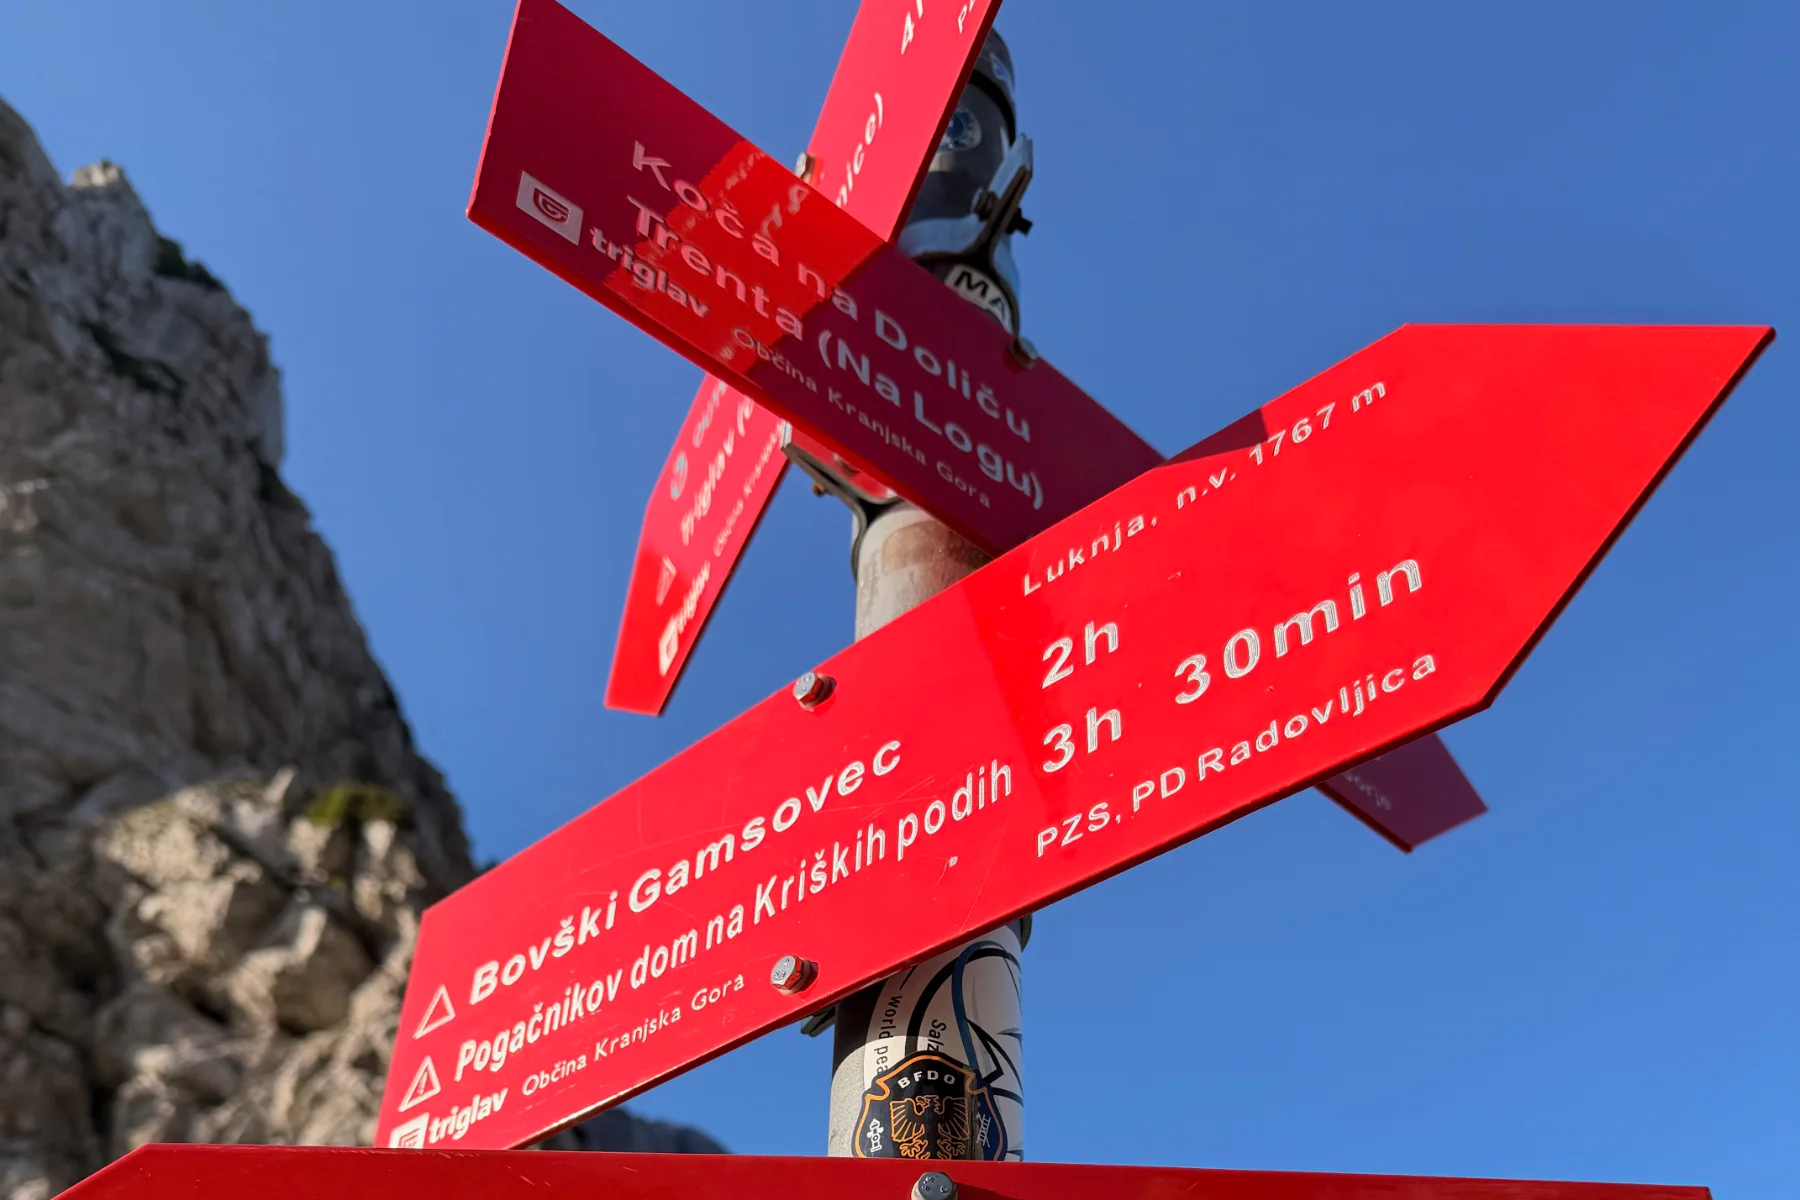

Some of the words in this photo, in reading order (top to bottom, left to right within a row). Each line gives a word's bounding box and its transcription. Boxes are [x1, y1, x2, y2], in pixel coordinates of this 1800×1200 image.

[590, 227, 710, 317] triglav
[733, 327, 818, 394] Občina
[828, 387, 926, 466] Kranjska
[936, 461, 990, 508] Gora
[627, 195, 803, 341] Trenta
[818, 330, 901, 407] (Na
[913, 391, 1043, 510] Logu)
[632, 140, 780, 266] Koča
[798, 263, 858, 321] na
[875, 309, 1030, 442] Doliču
[1024, 515, 1156, 596] Luknja,
[1177, 468, 1235, 509] n.v.
[1248, 403, 1335, 465] 1767
[1352, 382, 1385, 412] m
[455, 970, 622, 1082] Pogačnikov
[631, 929, 697, 989] dom
[706, 905, 744, 941] na
[753, 830, 886, 925] Kriških
[896, 761, 1011, 862] podih
[1043, 707, 1121, 772] 3h
[1175, 558, 1422, 706] 30min
[469, 892, 616, 1004] Bovški
[628, 739, 901, 914] Gamsovec
[1042, 622, 1118, 689] 2h
[1038, 802, 1120, 857] PZS,
[1133, 767, 1185, 812] PD
[1198, 654, 1436, 781] Radovljica
[429, 1088, 508, 1144] triglav
[522, 1055, 586, 1096] Občina
[594, 1006, 681, 1061] Kranjska
[691, 974, 744, 1010] Gora
[878, 995, 904, 1040] world
[897, 1070, 956, 1089] BFDO
